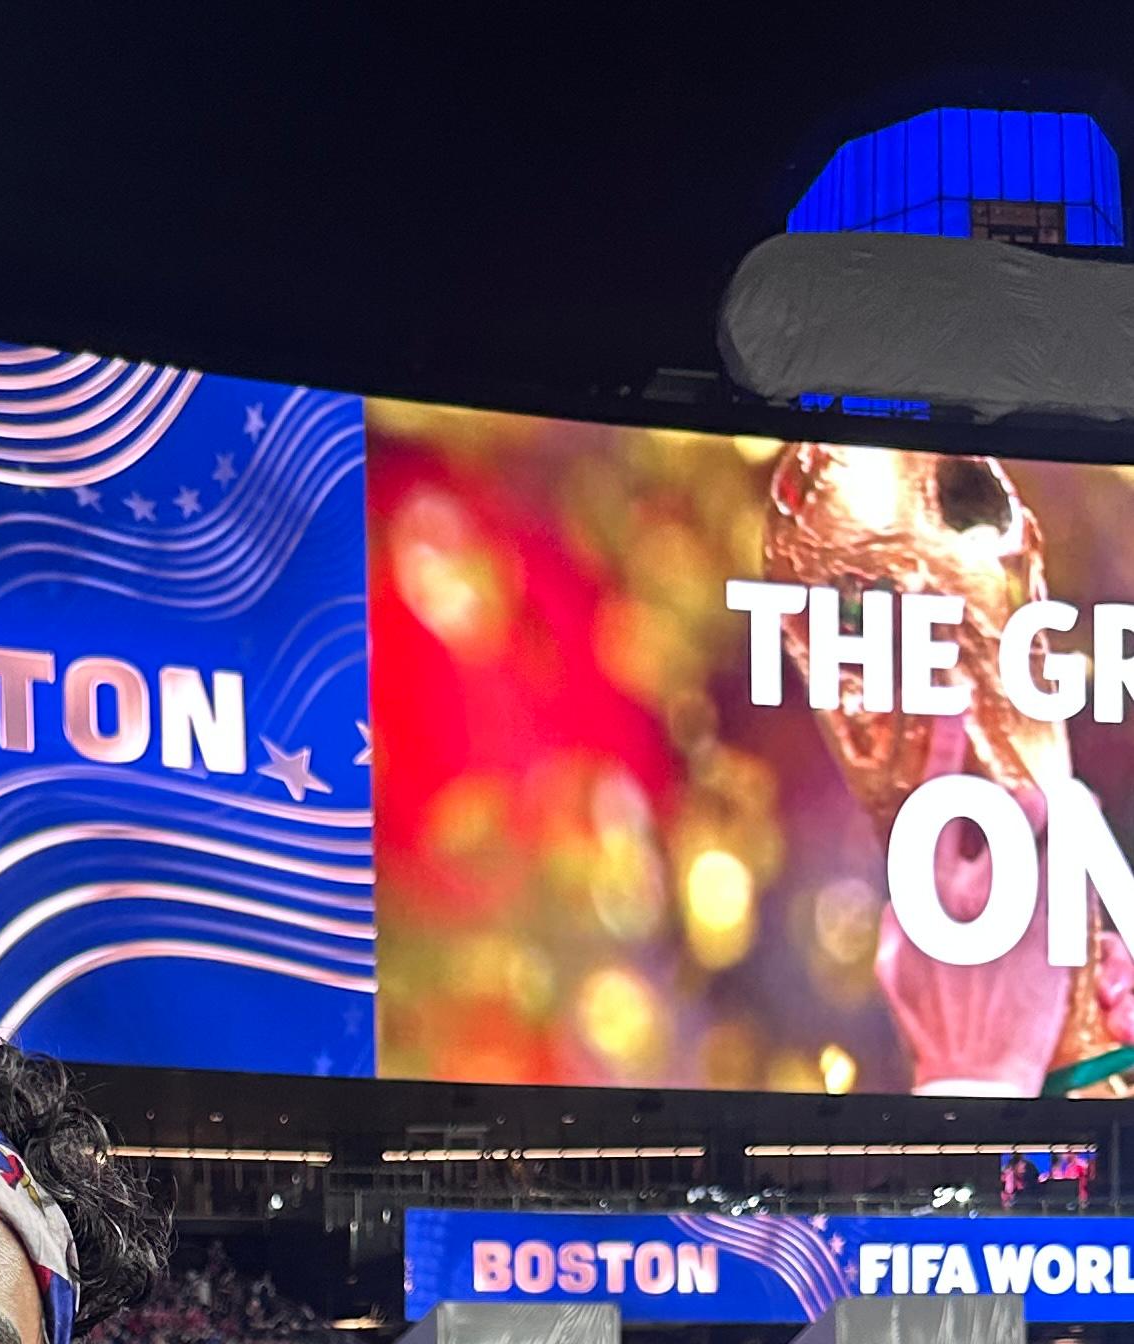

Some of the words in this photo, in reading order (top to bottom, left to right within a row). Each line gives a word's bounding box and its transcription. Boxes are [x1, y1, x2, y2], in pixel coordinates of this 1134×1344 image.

[726, 579, 971, 716] THE
[472, 1240, 719, 1294] BOSTON
[859, 1242, 978, 1294] FIFA
[982, 1243, 1134, 1294] WORL
